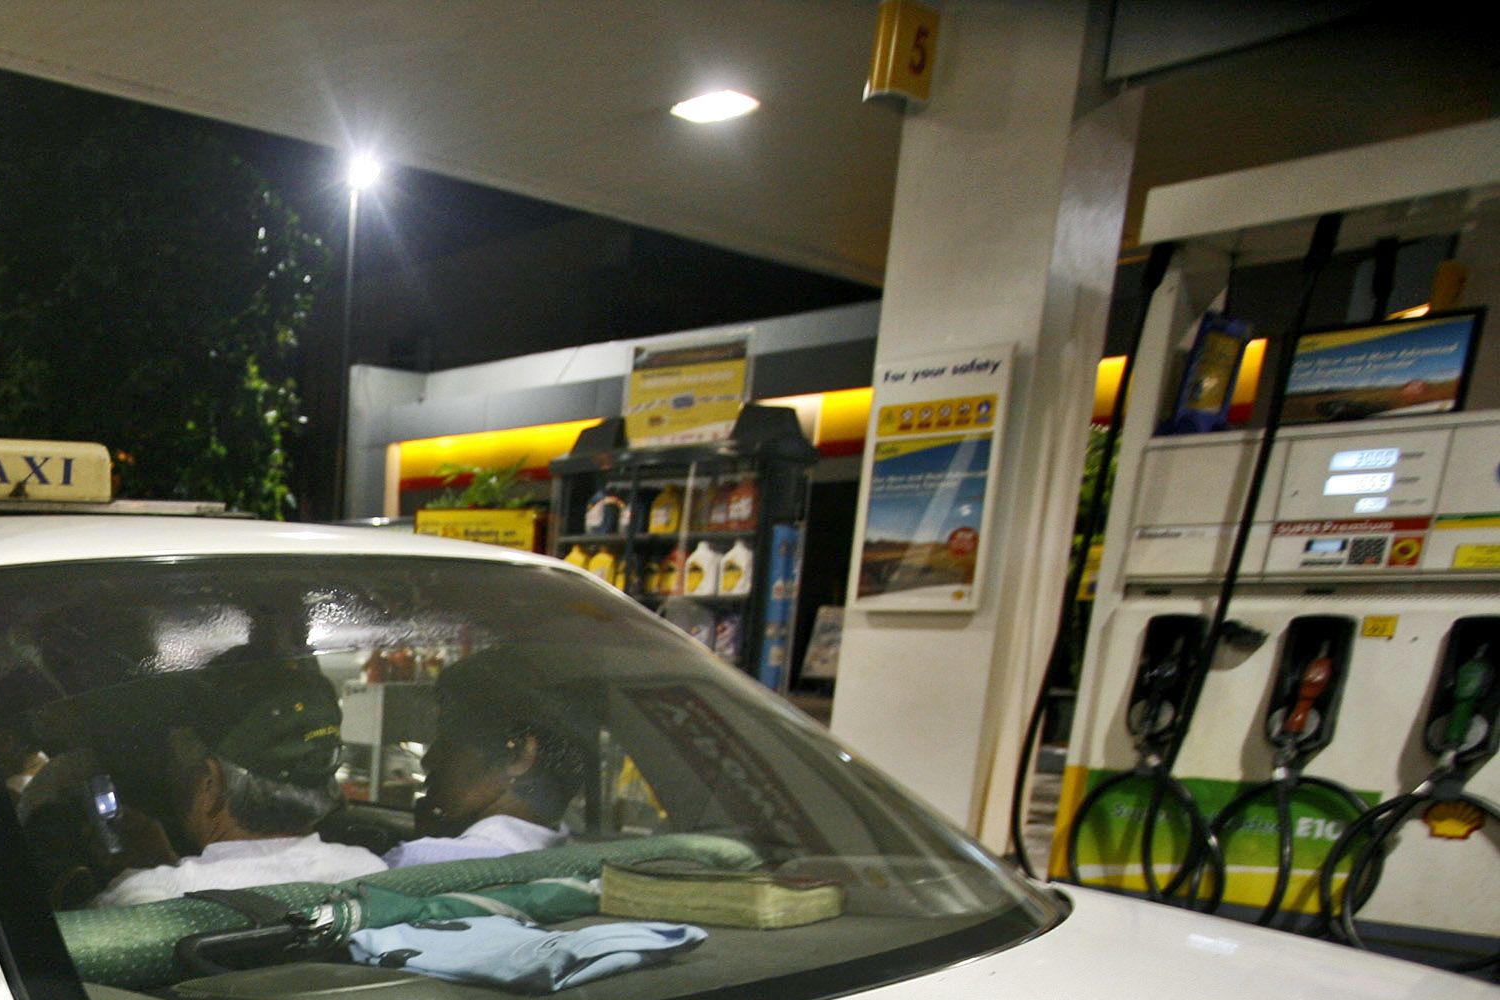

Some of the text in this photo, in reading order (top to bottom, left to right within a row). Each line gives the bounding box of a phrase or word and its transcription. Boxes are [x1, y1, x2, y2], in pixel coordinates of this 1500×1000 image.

[909, 26, 930, 75] 5
[884, 358, 1003, 383] For your safety
[1322, 517, 1395, 535] Premium
